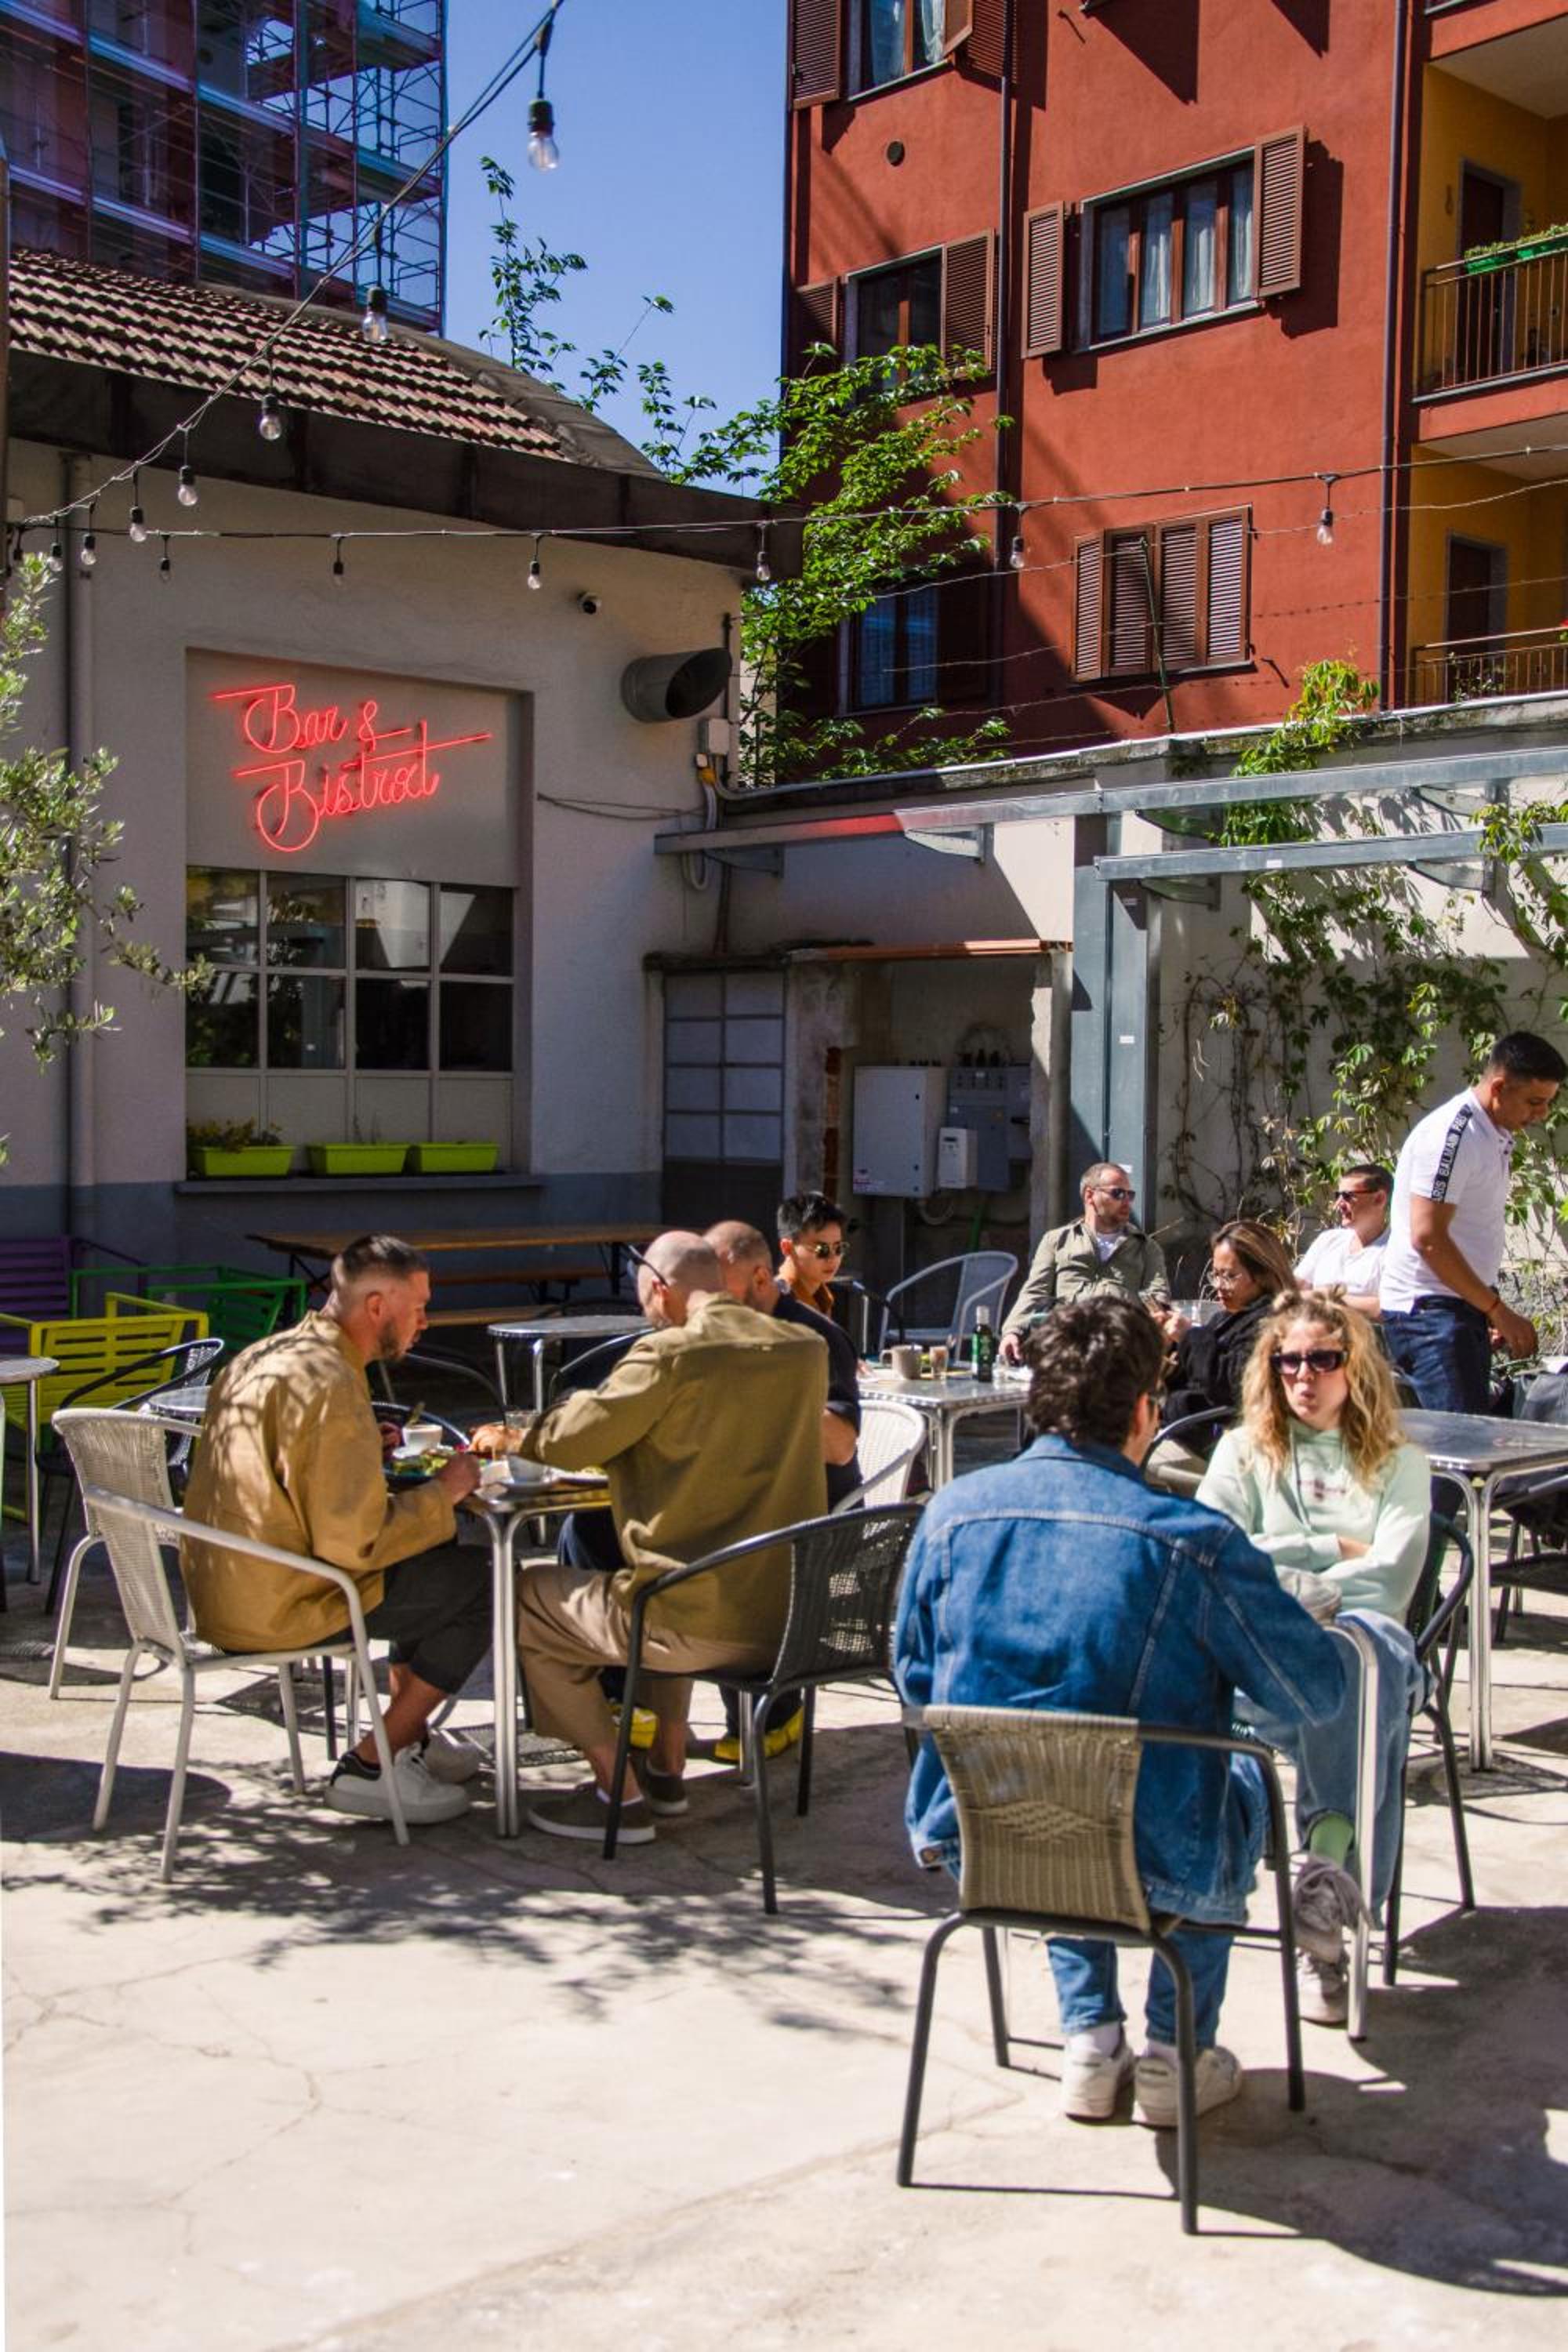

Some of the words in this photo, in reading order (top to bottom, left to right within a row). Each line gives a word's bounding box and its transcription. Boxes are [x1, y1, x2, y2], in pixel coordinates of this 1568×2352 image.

[214, 684, 348, 753] Bar
[358, 700, 412, 751] &
[235, 720, 493, 853] Bistrot
